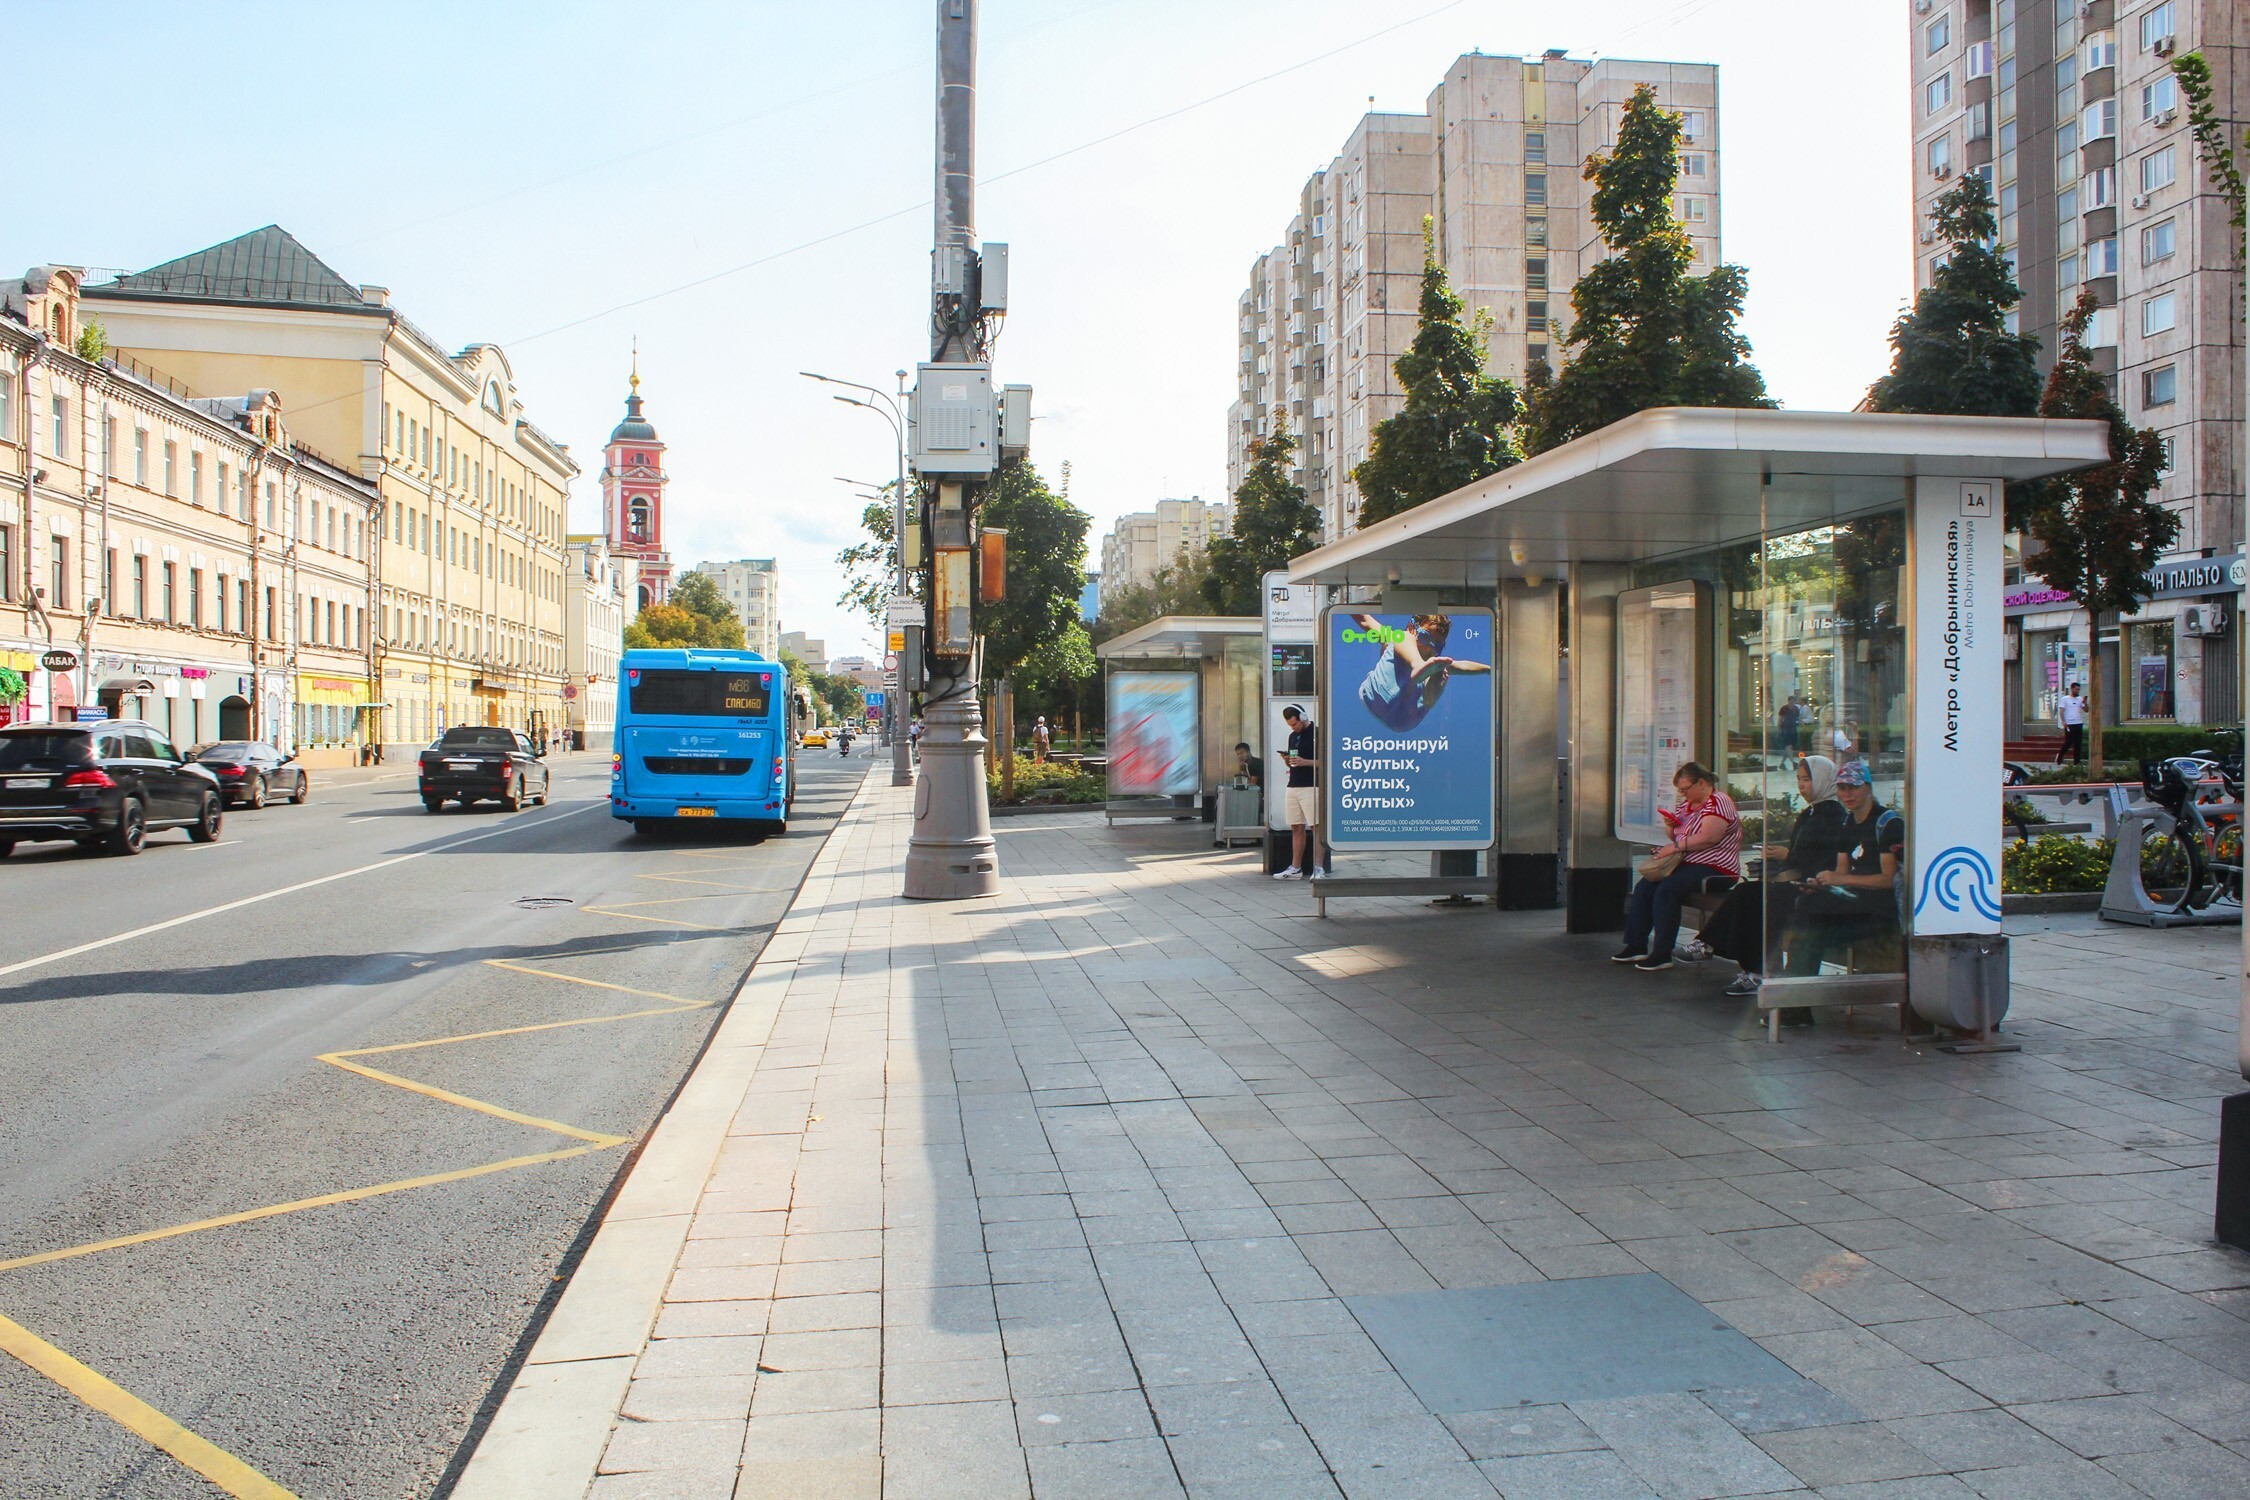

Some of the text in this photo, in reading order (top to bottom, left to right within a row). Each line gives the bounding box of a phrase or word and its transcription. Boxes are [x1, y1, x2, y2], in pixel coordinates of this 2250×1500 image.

[1963, 520, 1976, 649] Metro Dobryninskaya
[2170, 565, 2221, 589] ПАЛЬТО
[2004, 592, 2028, 607] СКОЙ
[1465, 628, 1480, 640] 0+
[1943, 520, 1961, 752] Метро «Добрынинская»
[43, 656, 75, 666] ТАБАК
[725, 697, 762, 709] СПАСИБО
[1341, 735, 1449, 754] Забронируй
[1341, 756, 1420, 773] «Бултых,
[1341, 774, 1411, 793] бултых,
[1341, 793, 1415, 812] бултых»
